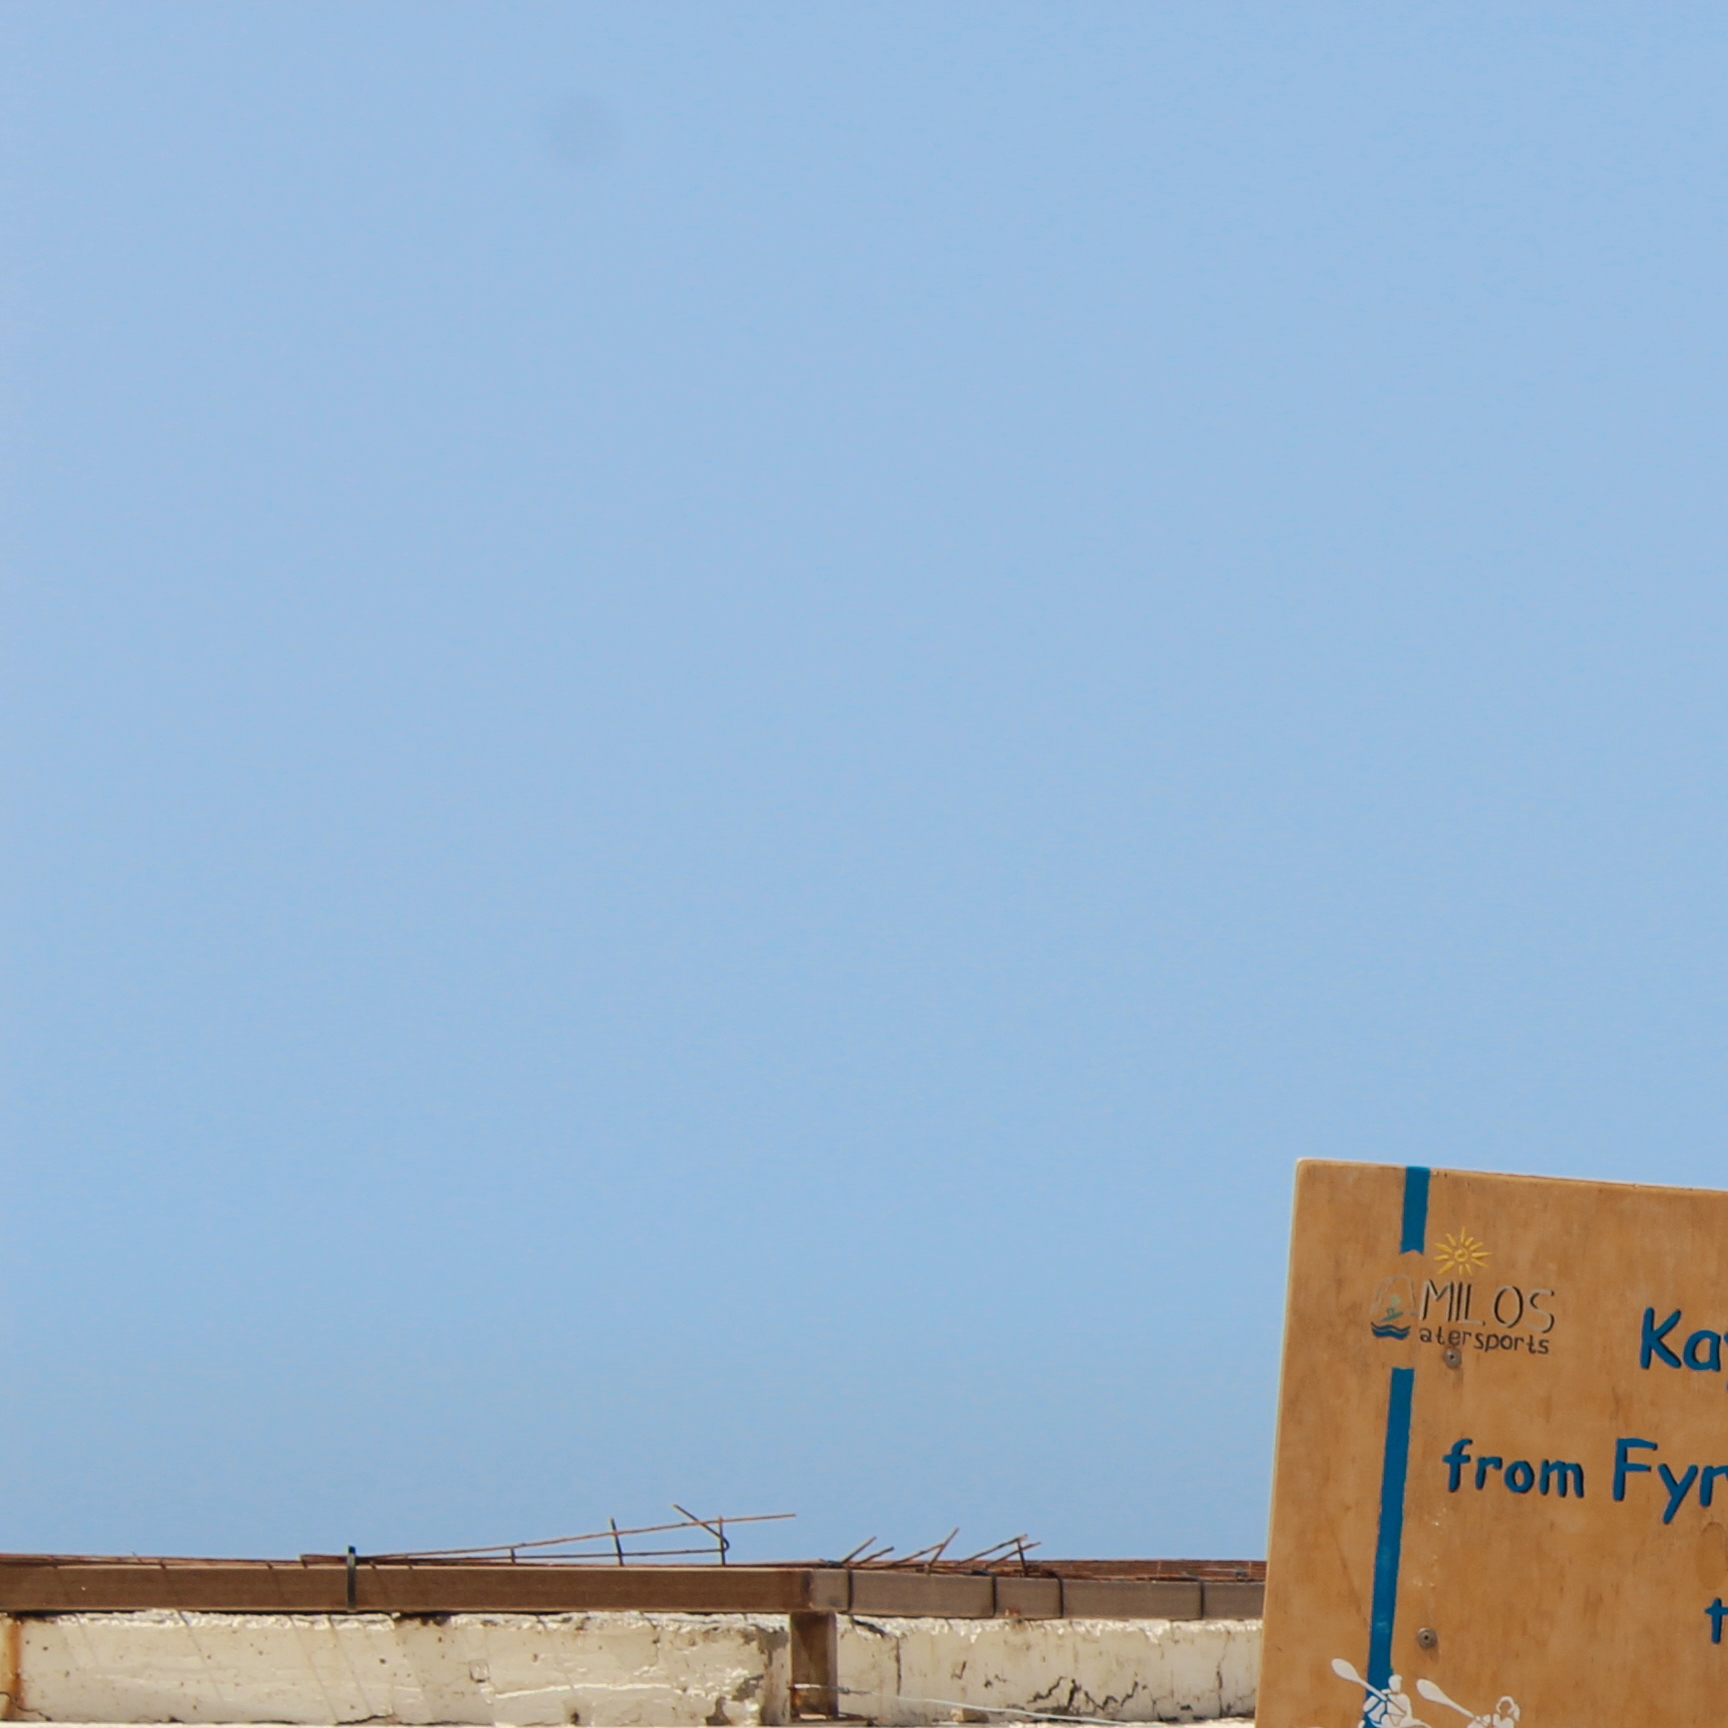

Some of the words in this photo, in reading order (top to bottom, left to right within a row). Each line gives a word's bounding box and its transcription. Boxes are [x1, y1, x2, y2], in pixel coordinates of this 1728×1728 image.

[1419, 1279, 1555, 1333] MILOS
[1419, 1326, 1550, 1355] atersports
[1442, 1438, 1585, 1499] from
